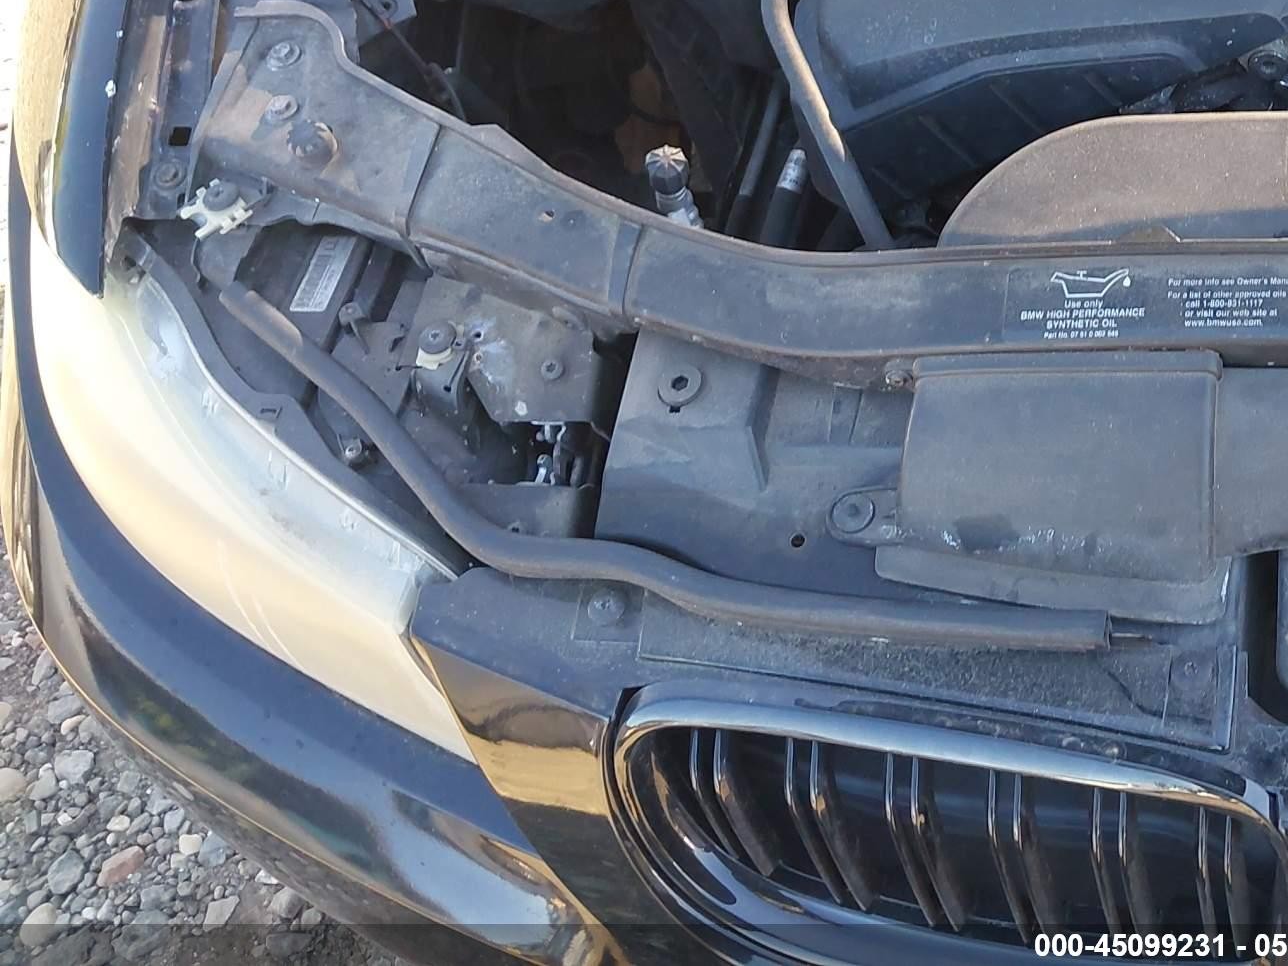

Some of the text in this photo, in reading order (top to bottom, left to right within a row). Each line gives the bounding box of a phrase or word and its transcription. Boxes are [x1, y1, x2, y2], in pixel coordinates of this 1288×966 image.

[1168, 278, 1181, 286] For
[1205, 277, 1220, 286] info
[1237, 277, 1268, 285] Owner's
[1167, 291, 1181, 299] For
[1213, 290, 1233, 298] other
[1234, 290, 1271, 299] approved
[1272, 290, 1287, 298] oils
[1064, 299, 1104, 309] Use only
[1185, 300, 1200, 308] call
[1020, 307, 1146, 320] BMW HIGH PERFORMANCE
[1196, 309, 1214, 317] visit
[1232, 308, 1250, 317] web
[1251, 308, 1268, 316] site
[1269, 308, 1278, 316] at
[1046, 319, 1117, 329] SYNTHETIC OIL
